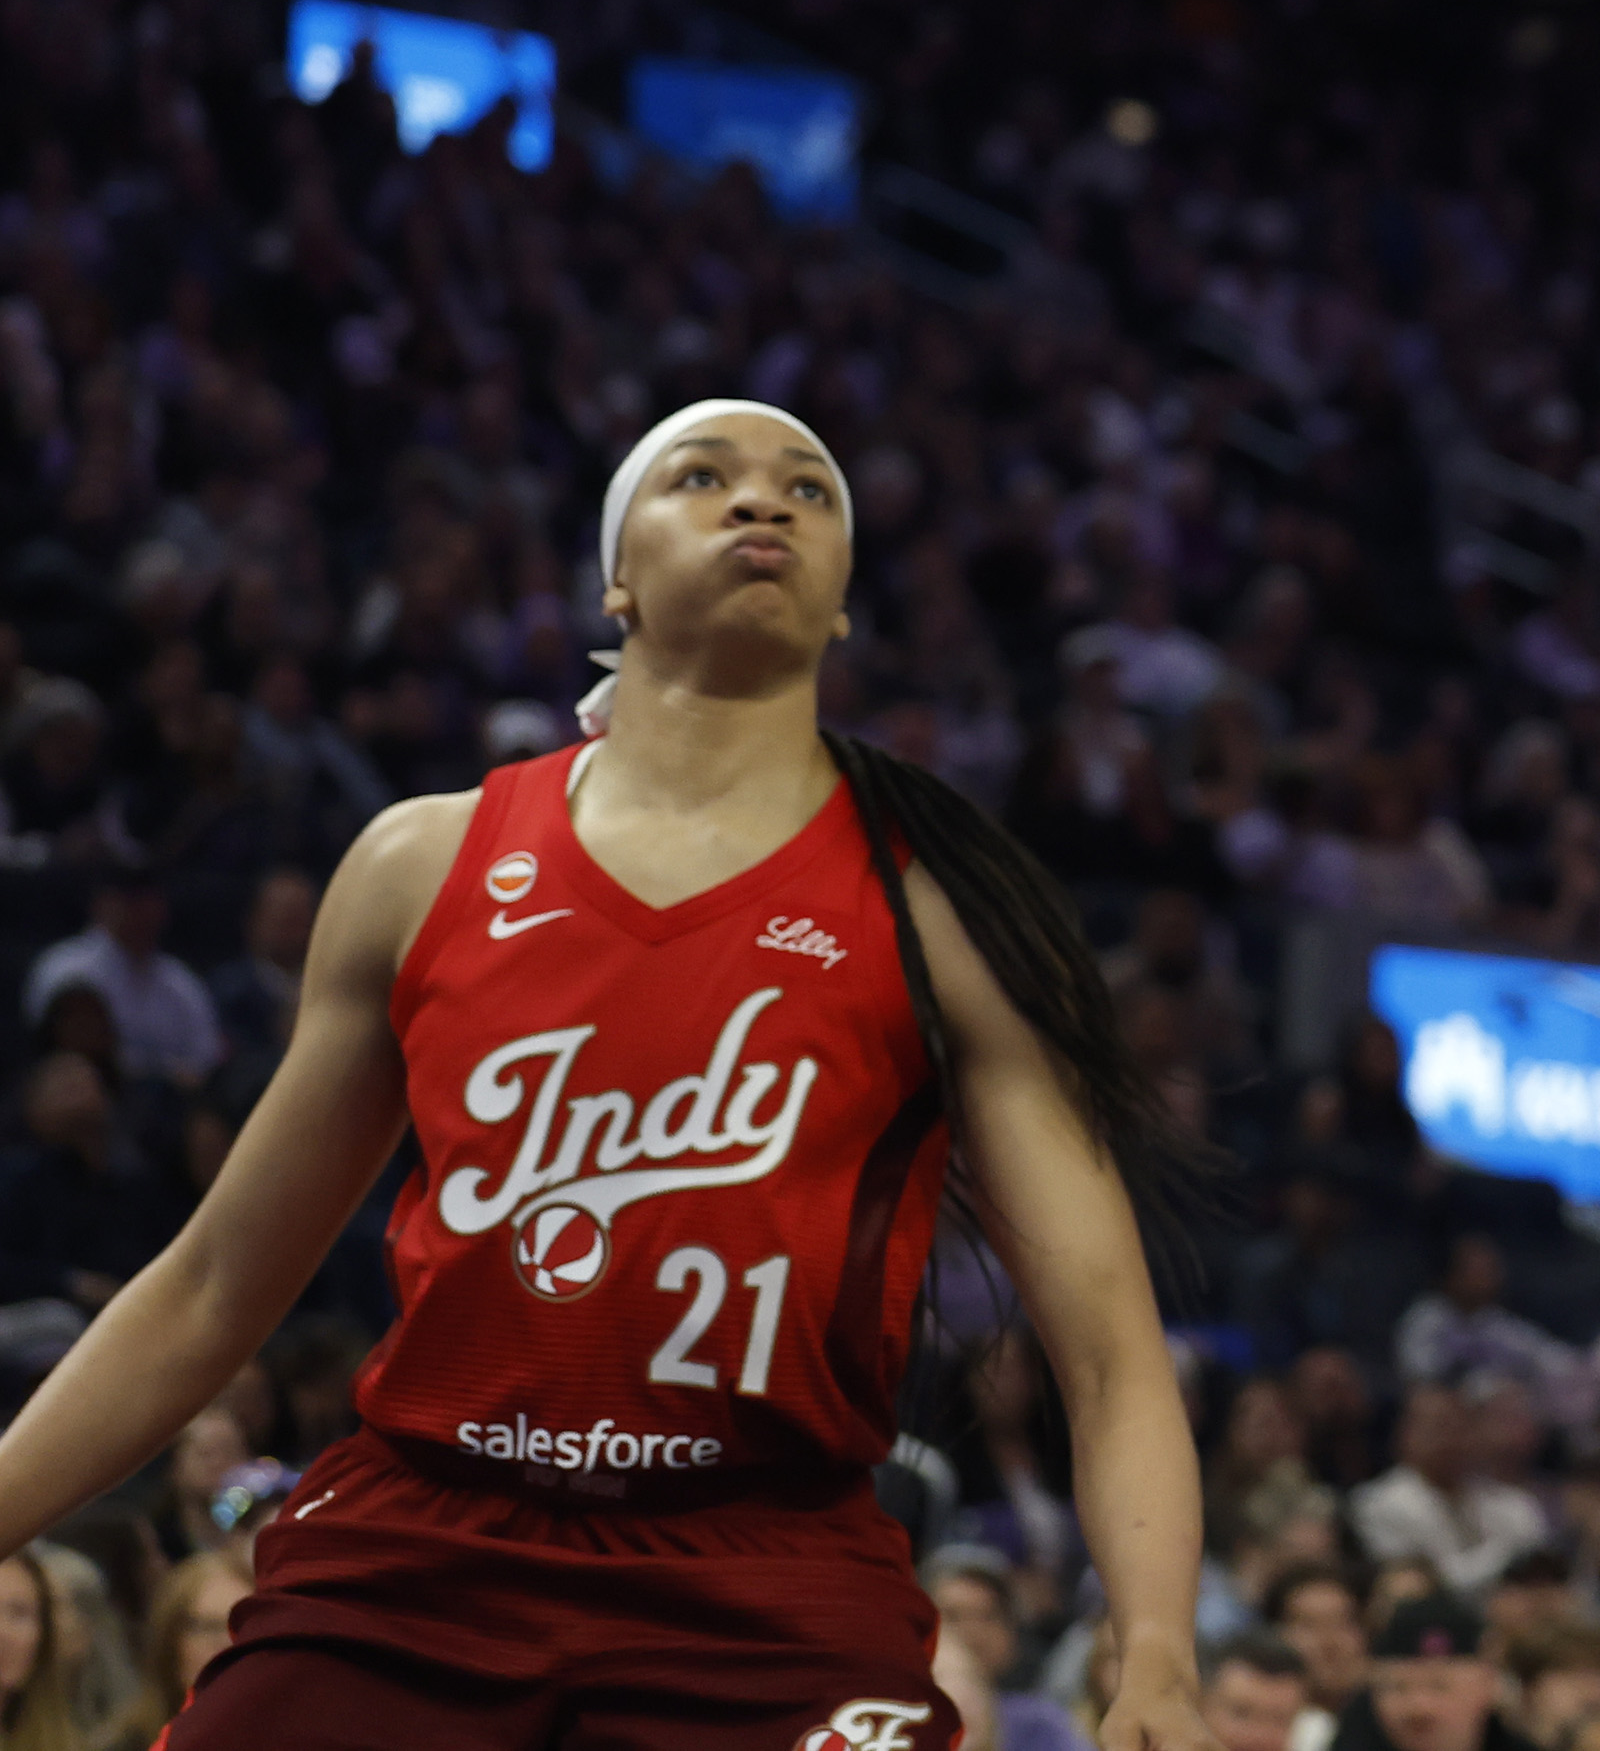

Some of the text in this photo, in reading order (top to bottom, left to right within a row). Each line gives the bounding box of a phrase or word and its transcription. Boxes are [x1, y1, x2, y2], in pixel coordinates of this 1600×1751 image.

[438, 986, 818, 1235] Indy
[648, 1246, 790, 1395] 21
[457, 1412, 722, 1474] salesforce
